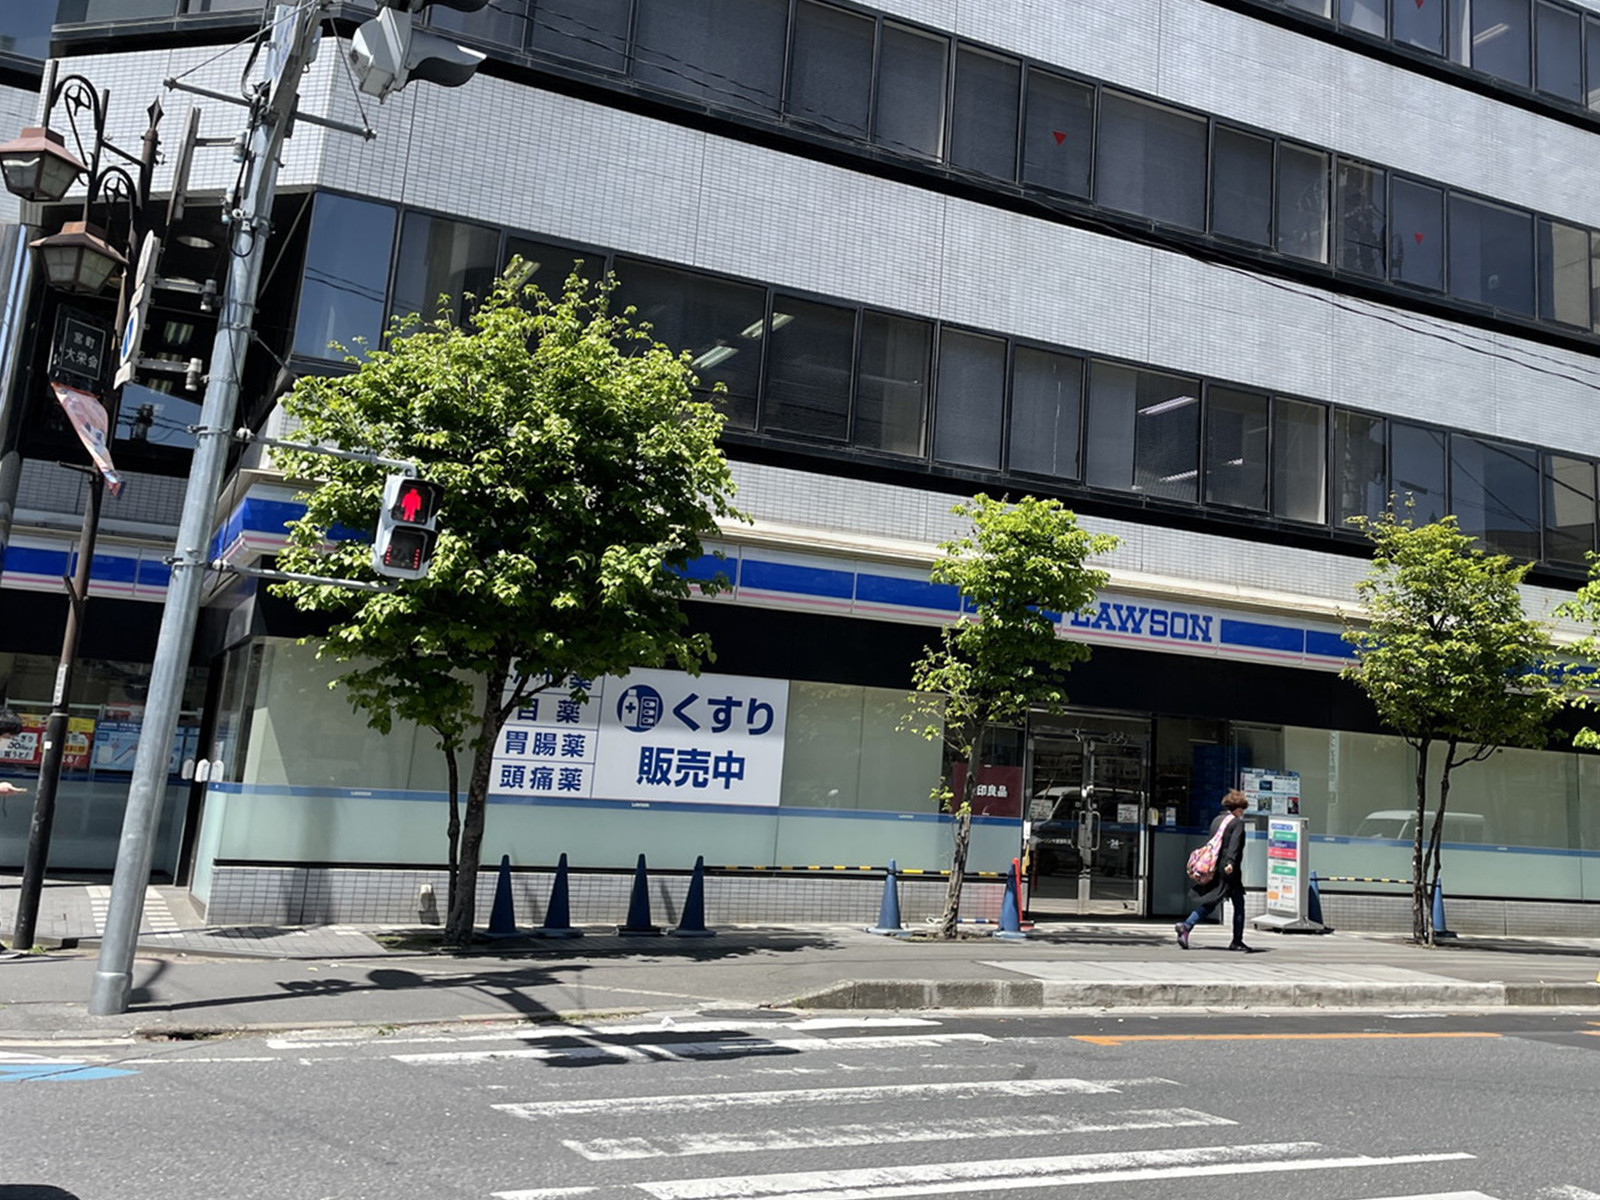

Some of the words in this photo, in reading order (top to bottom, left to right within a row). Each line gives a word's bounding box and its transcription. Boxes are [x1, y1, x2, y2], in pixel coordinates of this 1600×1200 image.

[64, 347, 99, 369] 大栄会
[1070, 601, 1213, 643] LAWSON
[516, 698, 581, 724] 目薬
[672, 692, 775, 736] くすり
[505, 730, 587, 758] 胃腸薬
[499, 763, 583, 792] 頭痛薬
[636, 746, 746, 790] 販売中
[973, 784, 1008, 798] 印良品
